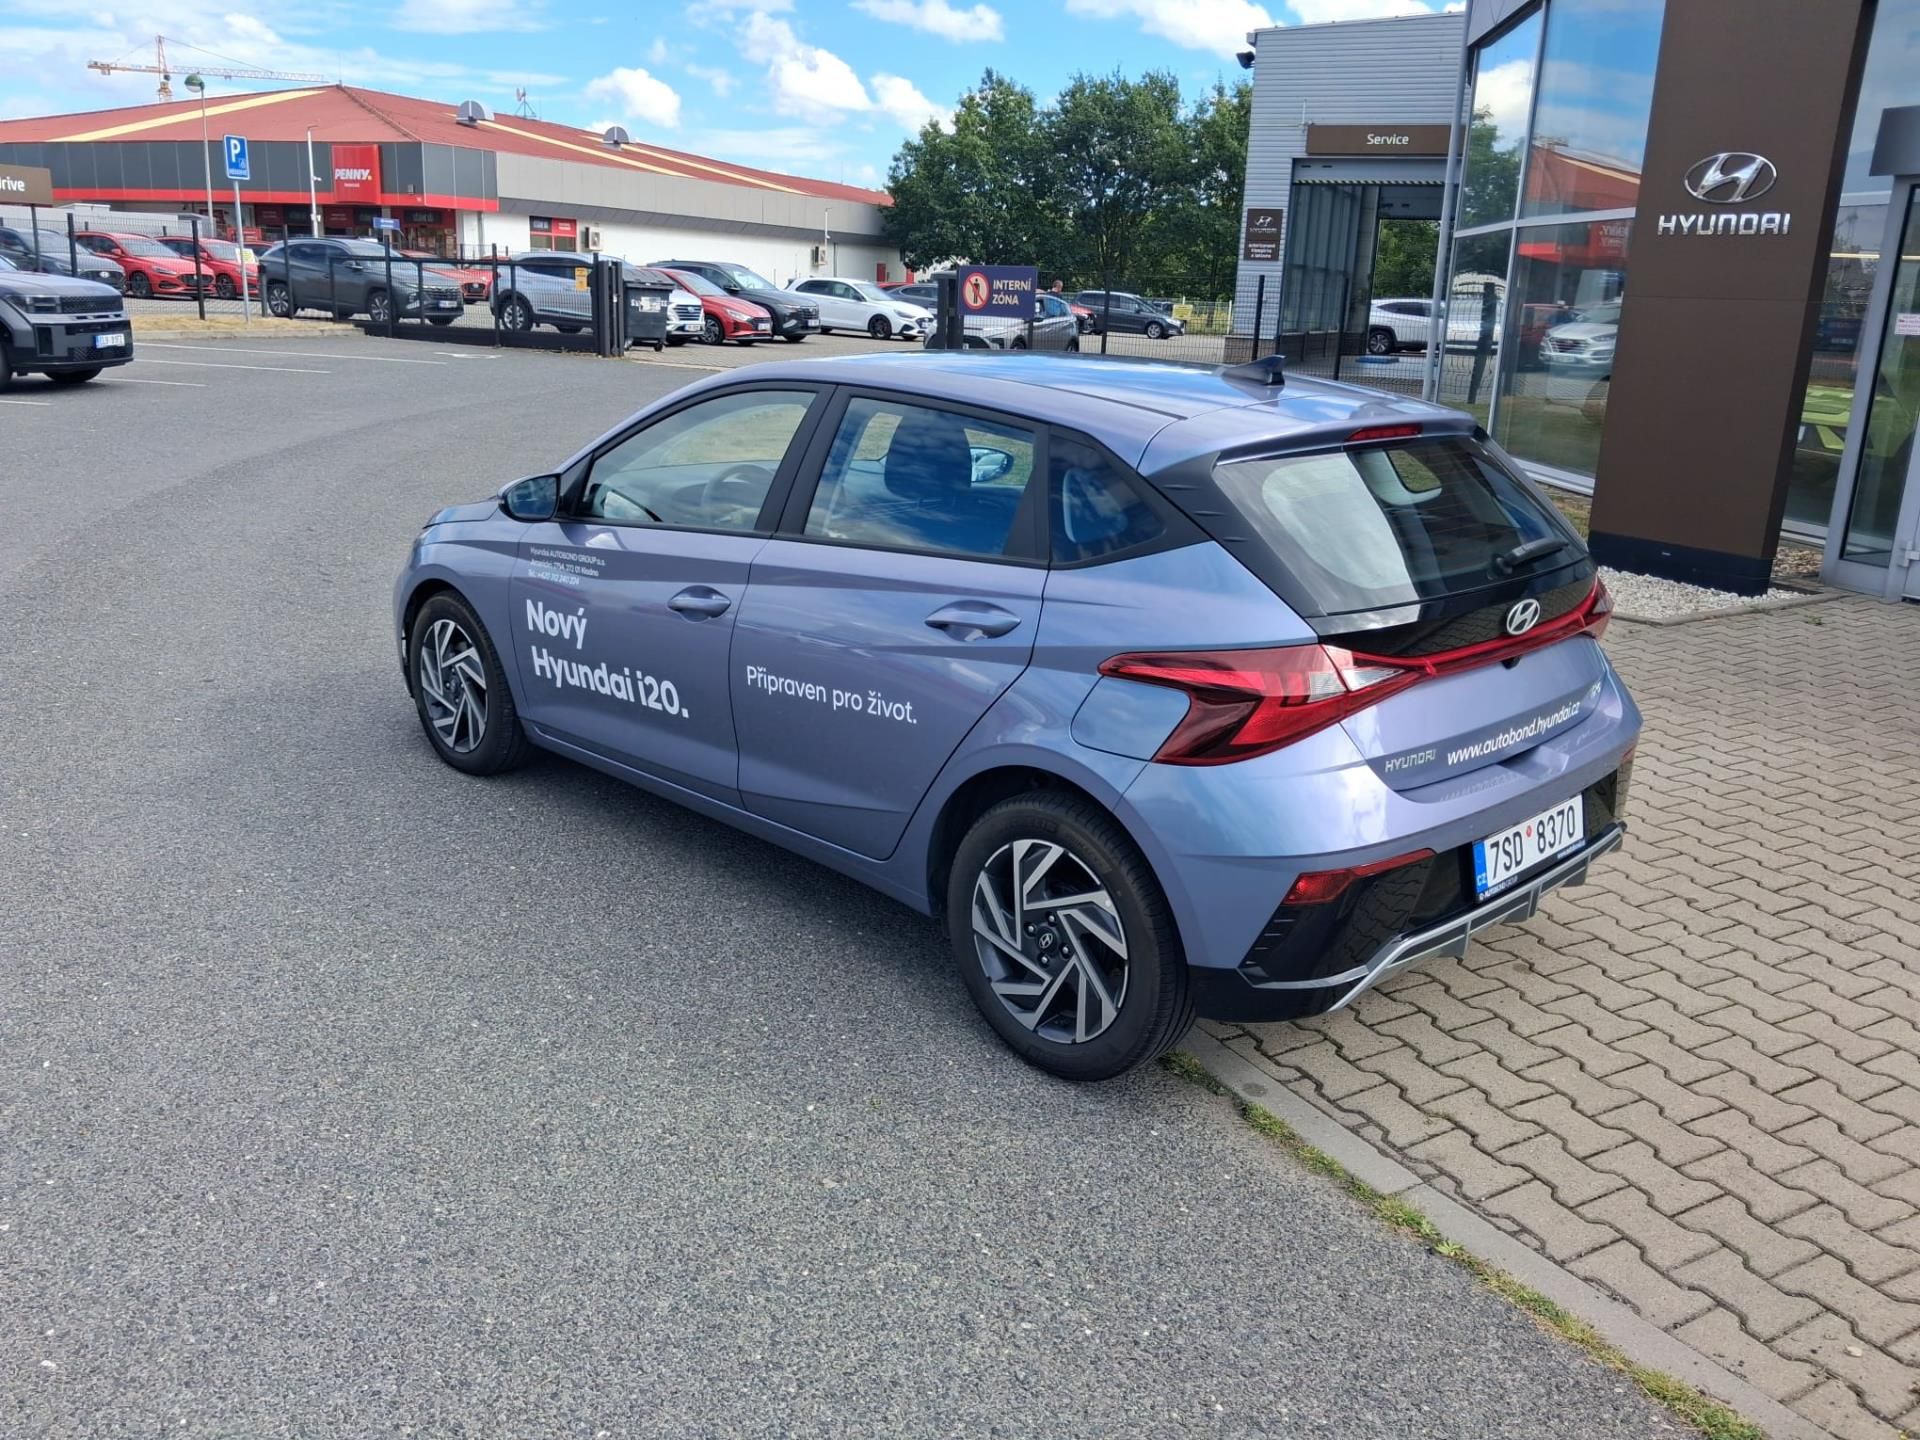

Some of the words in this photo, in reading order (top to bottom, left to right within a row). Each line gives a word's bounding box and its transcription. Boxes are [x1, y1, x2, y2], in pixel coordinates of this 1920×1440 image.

[230, 139, 241, 162] P
[1366, 133, 1409, 145] Service
[1657, 213, 1791, 235] HYUNDAI
[993, 278, 1032, 291] INTERNÍ
[992, 292, 1019, 305] ZÓNA
[526, 599, 587, 650] Nový
[531, 645, 635, 702] Hyundai
[636, 670, 689, 718] i20.
[746, 665, 827, 703] Připraven
[832, 689, 863, 711] pro
[867, 690, 917, 724] život.
[1447, 701, 1581, 766] www.autobond.hyundai.cz
[1384, 749, 1437, 773] HYUNDAI
[1490, 831, 1524, 880] 7SD
[1536, 805, 1576, 854] 8370
